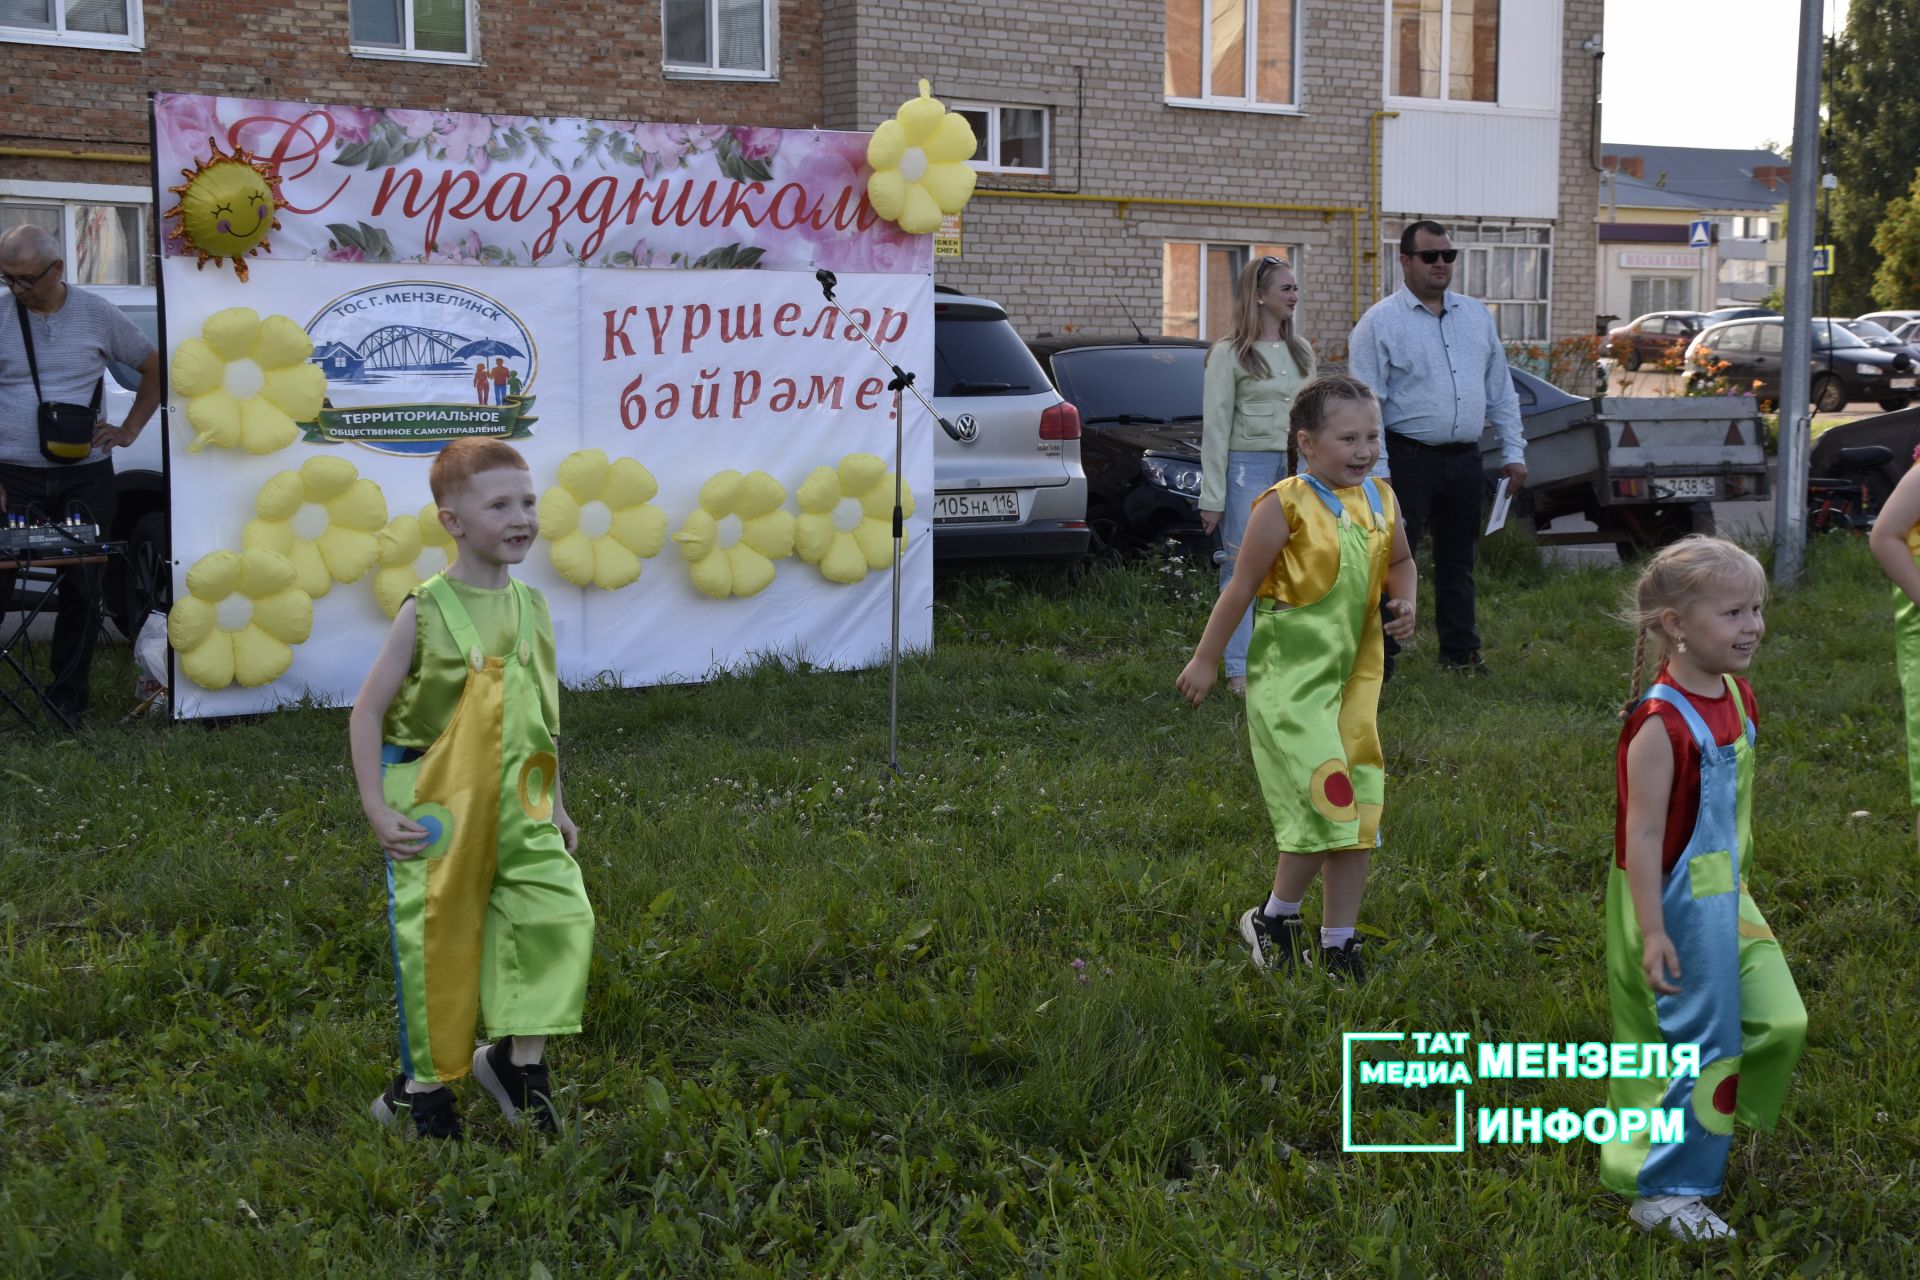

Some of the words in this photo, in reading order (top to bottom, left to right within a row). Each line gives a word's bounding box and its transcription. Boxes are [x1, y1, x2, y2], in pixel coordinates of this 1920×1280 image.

[227, 110, 351, 215] С
[371, 167, 879, 262] праздником
[332, 299, 367, 319] ТОС
[385, 292, 502, 322] МЕНЗЕЛИНСК
[341, 411, 500, 425] ТЕРРИТОРИАЛЬНОЕ
[330, 428, 412, 437] ОБЩЕСТВЕННОЕ
[414, 425, 507, 436] САМОУПРАВЛЕНИЕ
